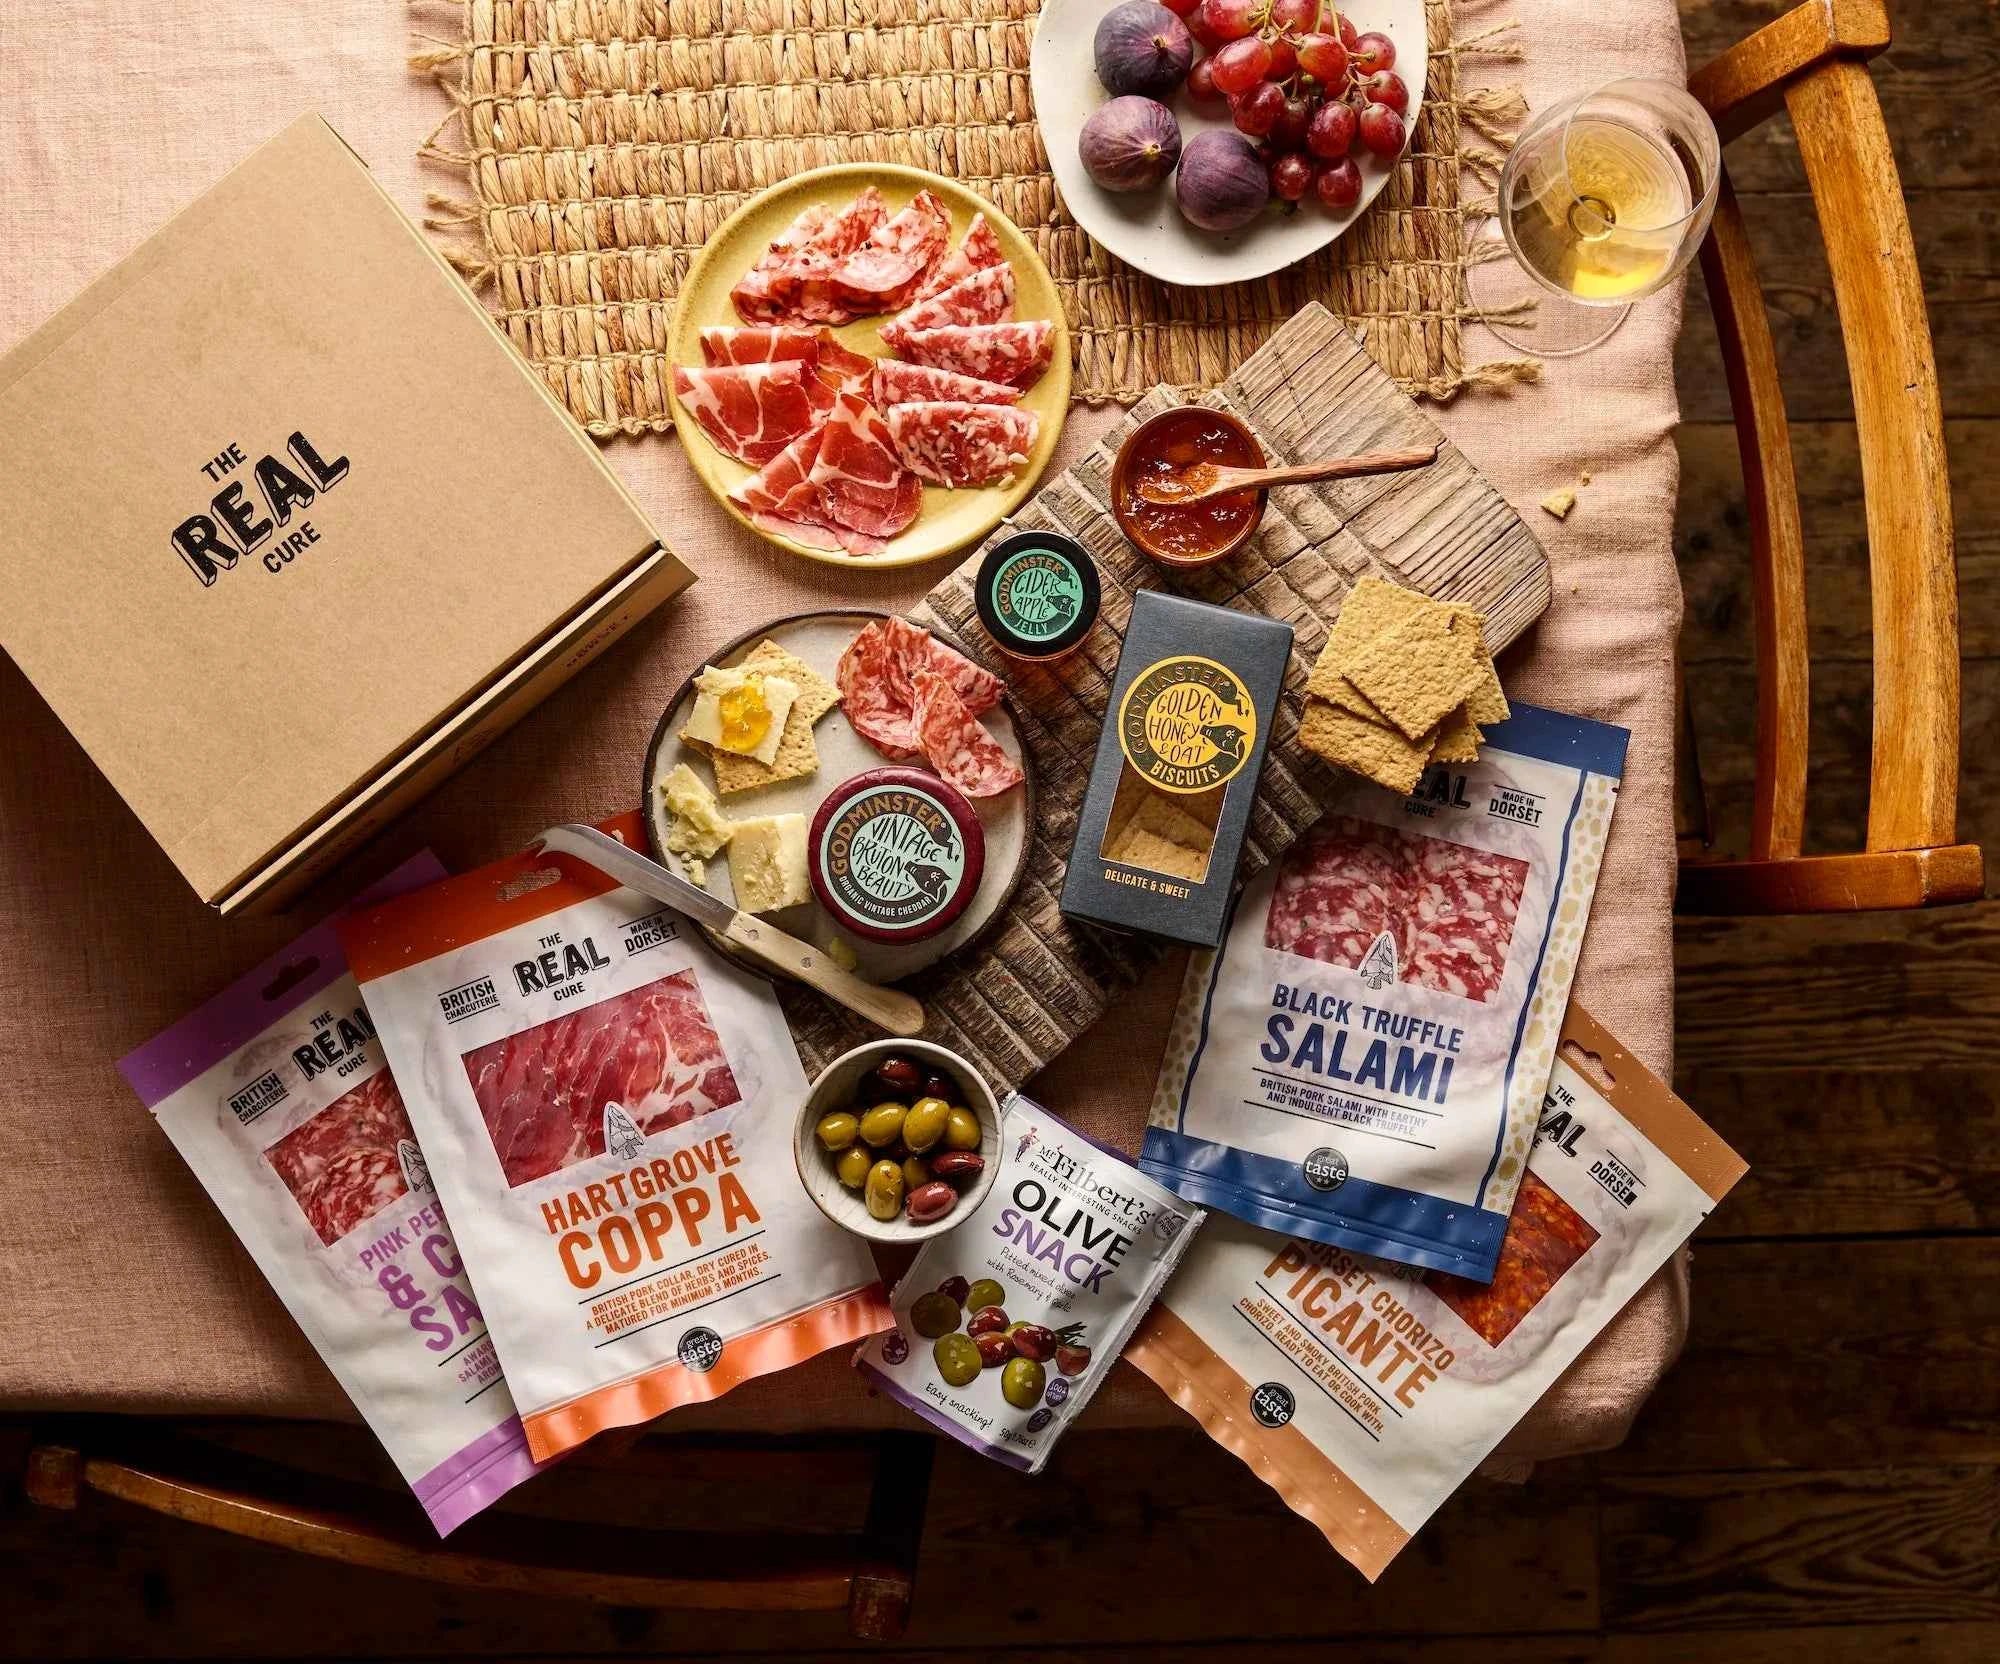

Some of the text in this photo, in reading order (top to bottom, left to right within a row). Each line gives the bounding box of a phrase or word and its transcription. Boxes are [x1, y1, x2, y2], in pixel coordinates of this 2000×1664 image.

[200, 441, 248, 483] THE
[171, 431, 350, 588] REAL
[262, 520, 321, 574] CURE
[999, 556, 1065, 615] GODMINSTER
[1014, 569, 1062, 596] CIDER
[1013, 618, 1049, 635] JELLY
[1014, 596, 1052, 619] APPLE
[1127, 664, 1227, 755] GODMINSTER
[1156, 687, 1222, 721] GOLDEN
[1149, 715, 1200, 745] HONEY
[1150, 759, 1220, 786] BISCUITS
[1170, 745, 1203, 764] OAT
[1413, 770, 1472, 810] AL
[1489, 799, 1543, 823] DORSET
[1502, 791, 1536, 807] MADE IN
[831, 794, 943, 876] GODMINSTER
[872, 814, 943, 862] VINTAGE
[852, 836, 905, 878] BRUTON
[838, 875, 932, 917] ORGANIC VINTAGE CHEDDAR
[857, 864, 915, 898] BEAUTY
[1104, 868, 1191, 899] DELICATE & SWEET
[538, 932, 563, 949] THE
[624, 921, 678, 953] DORSET
[629, 915, 664, 935] MADE IN
[512, 937, 610, 997] REAL
[440, 980, 496, 1012] BRITISH
[445, 994, 499, 1021] CHARCUTERIE
[553, 981, 586, 1002] CURE
[310, 1010, 334, 1031] THE
[1271, 983, 1464, 1053] BLACK TRUFFLE
[337, 1052, 368, 1078] CURE
[1260, 1013, 1454, 1105] SALAMI
[230, 1072, 282, 1114] BRITISH
[238, 1085, 288, 1123] CHARCUTERIE
[1260, 1078, 1428, 1129] BRITISH PORK SALAMI WITH EARTHY
[1266, 1091, 1286, 1104] AND
[1288, 1096, 1341, 1120] INDULGENT
[1342, 1109, 1372, 1126] BLACK
[1555, 1085, 1576, 1107] THE
[1537, 1092, 1586, 1157] AL
[541, 1132, 741, 1234] HARTGROVE
[1306, 1160, 1346, 1181] taste
[1590, 1160, 1638, 1206] DORSE
[1608, 1160, 1636, 1188] MADE IN
[1028, 1161, 1058, 1184] REALLY
[1058, 1181, 1111, 1216] INTERESTING
[1111, 1213, 1144, 1236] SNACKS
[558, 1171, 761, 1289] COPPA
[1013, 1179, 1133, 1268] OLIVE
[359, 1226, 411, 1272] PINK
[992, 1208, 1114, 1295] SNACK
[378, 1265, 426, 1310] &
[586, 1319, 594, 1330] A
[594, 1301, 638, 1327] DELICATE
[639, 1291, 669, 1310] BLEND
[671, 1285, 685, 1299] OF
[685, 1275, 716, 1294] HERBS
[717, 1264, 735, 1280] AND
[591, 1296, 628, 1317] BRITISH
[629, 1285, 655, 1304] PORK
[697, 1261, 716, 1278] DRY
[717, 1250, 746, 1269] CURED
[746, 1243, 760, 1258] IN
[605, 1310, 648, 1335] MATURED
[650, 1302, 669, 1317] FOR
[671, 1286, 714, 1311] MINIMUM
[714, 1282, 722, 1294] 3
[1263, 1241, 1438, 1409] PICANTE
[681, 1340, 721, 1362] taste
[1370, 1291, 1456, 1371] CHORIZO
[1256, 1298, 1382, 1415] SWEET AND SMOKY BRITISH PORK
[1274, 1330, 1303, 1357] READY
[1300, 1353, 1313, 1367] TO
[1311, 1361, 1332, 1382] EAT
[1327, 1379, 1341, 1394] OR
[1339, 1391, 1364, 1414] COOK
[925, 1382, 994, 1431] Easy snacking!
[1255, 1388, 1289, 1424] taste
